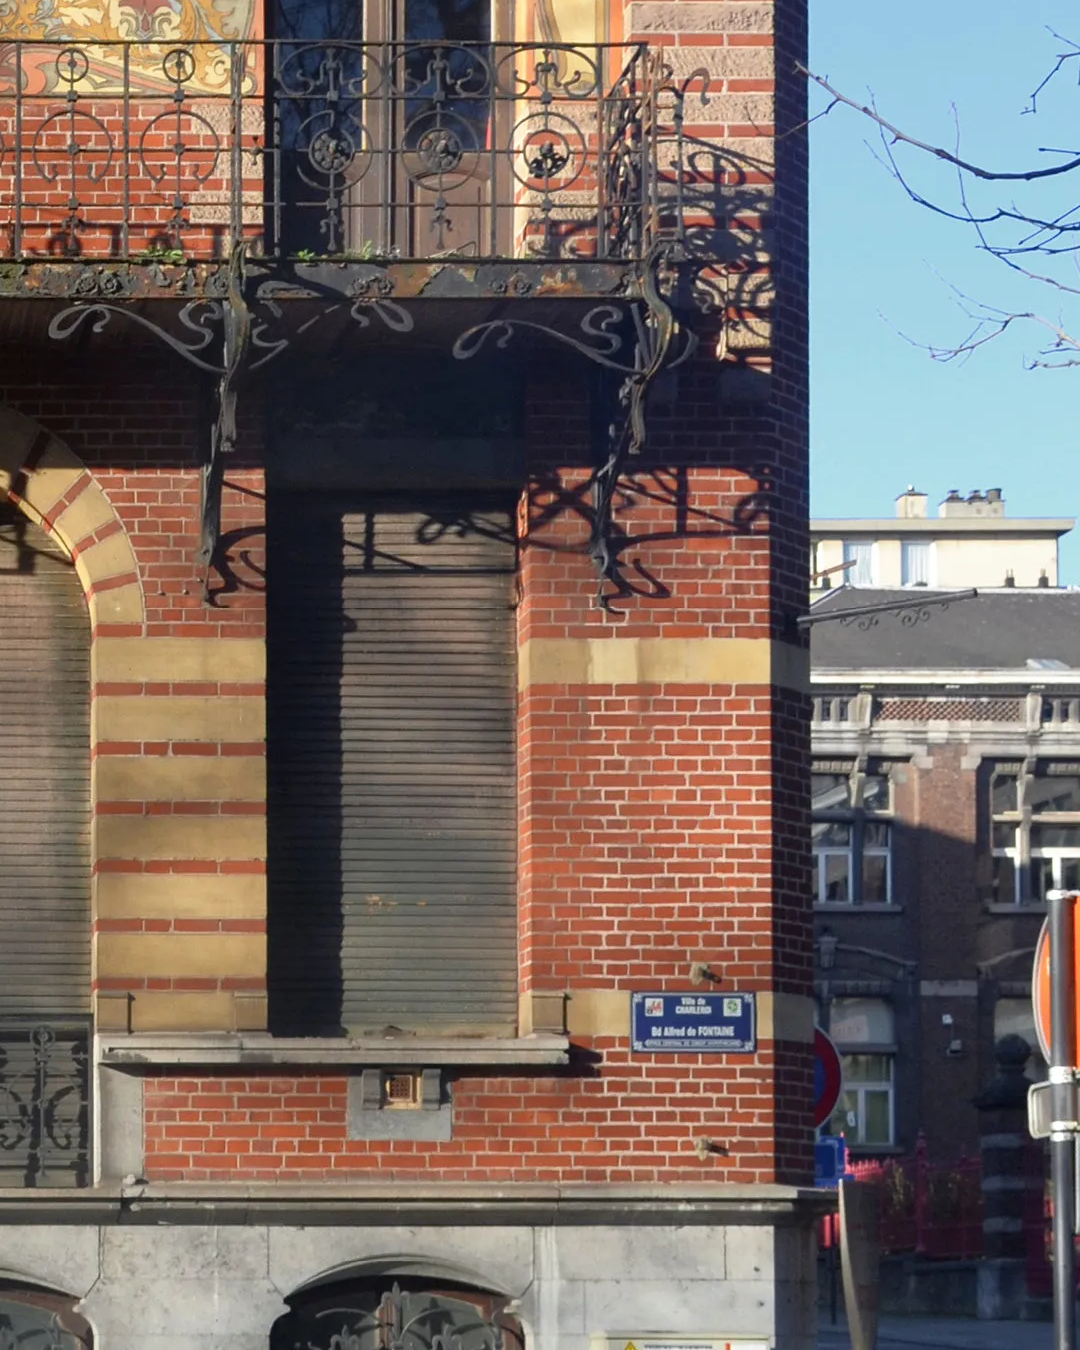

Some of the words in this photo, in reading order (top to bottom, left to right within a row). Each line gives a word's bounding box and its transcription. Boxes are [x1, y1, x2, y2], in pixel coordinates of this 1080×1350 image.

[681, 997, 696, 1005] Ville
[697, 997, 706, 1005] de
[675, 1006, 712, 1014] CHARLEROI
[651, 1026, 662, 1037] Bd
[663, 1026, 686, 1037] Alfred
[687, 1026, 697, 1037] de
[698, 1026, 735, 1036] FONTAINE
